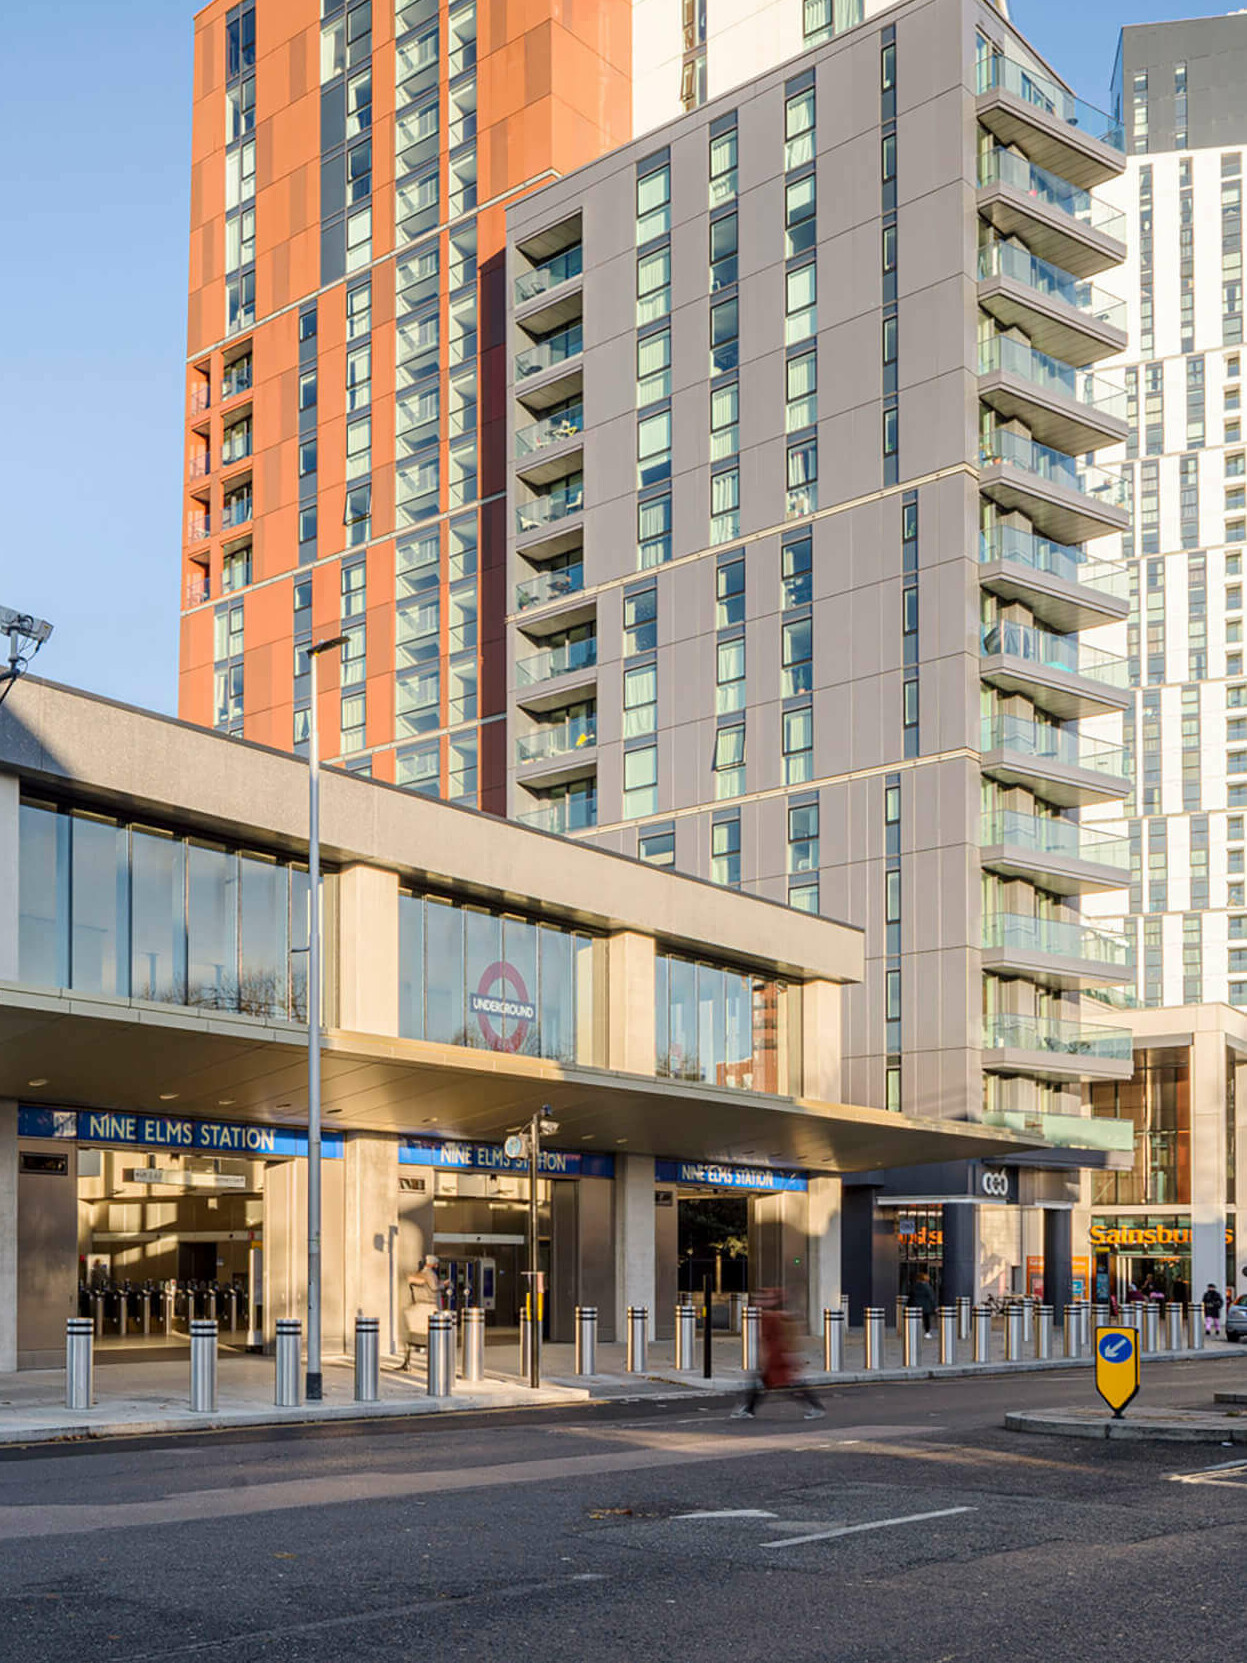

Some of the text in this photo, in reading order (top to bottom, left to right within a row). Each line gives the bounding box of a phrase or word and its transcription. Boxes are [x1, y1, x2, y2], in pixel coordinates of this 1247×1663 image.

[472, 997, 534, 1018] UNDERGROUND
[90, 1114, 275, 1150] NINE ELMS STATION
[440, 1145, 472, 1165] NINE
[682, 1164, 706, 1181] NINE
[735, 1168, 773, 1186] STATION
[1090, 1224, 1234, 1244] Sainsbus
